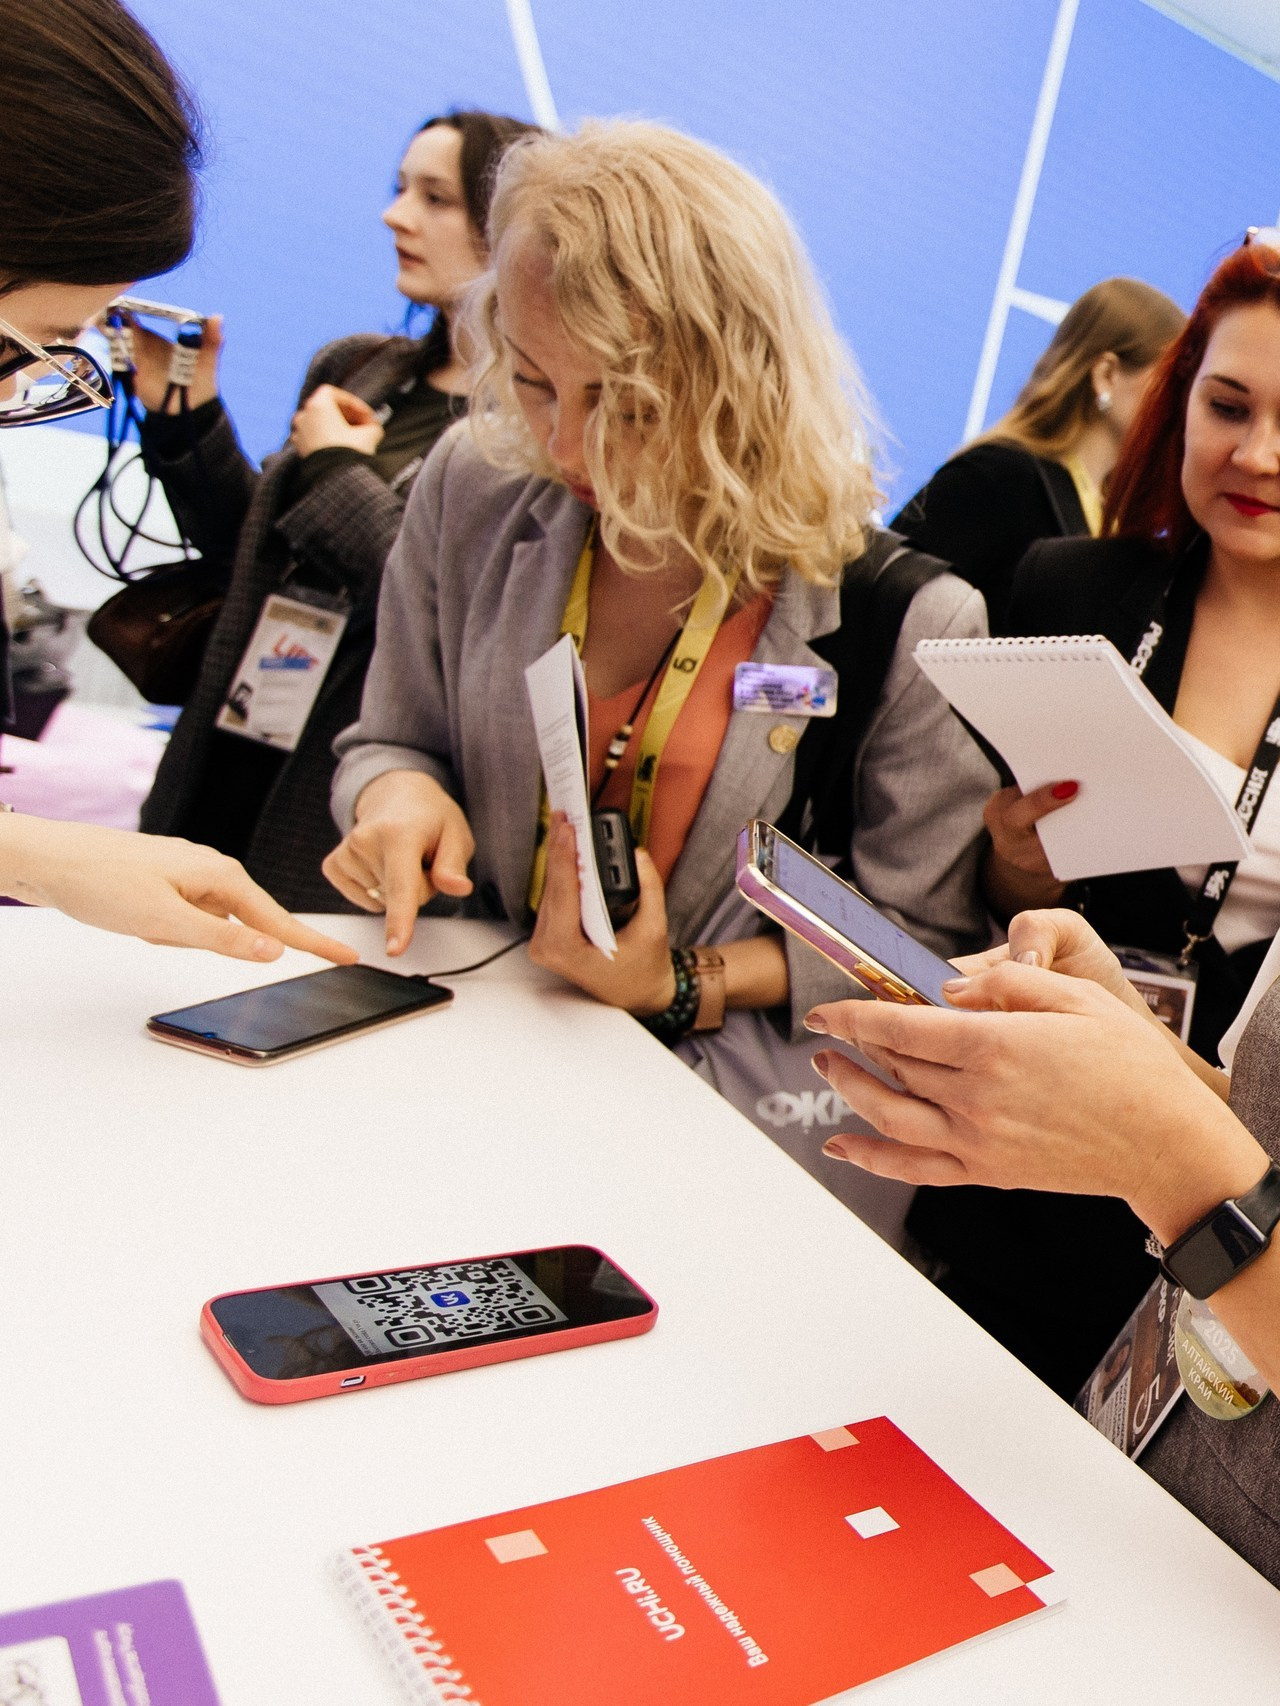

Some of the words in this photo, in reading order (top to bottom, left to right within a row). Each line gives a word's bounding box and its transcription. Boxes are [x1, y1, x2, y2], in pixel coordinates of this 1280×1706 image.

[1238, 766, 1268, 825] ССИЯ
[1204, 1319, 1239, 1365] 2025
[1181, 1339, 1235, 1405] АЛТАЙСКИЙ
[1188, 1367, 1213, 1401] КРАЙ
[641, 1515, 697, 1576] помощник
[685, 1574, 747, 1637] надежный
[738, 1635, 769, 1668] Ваш
